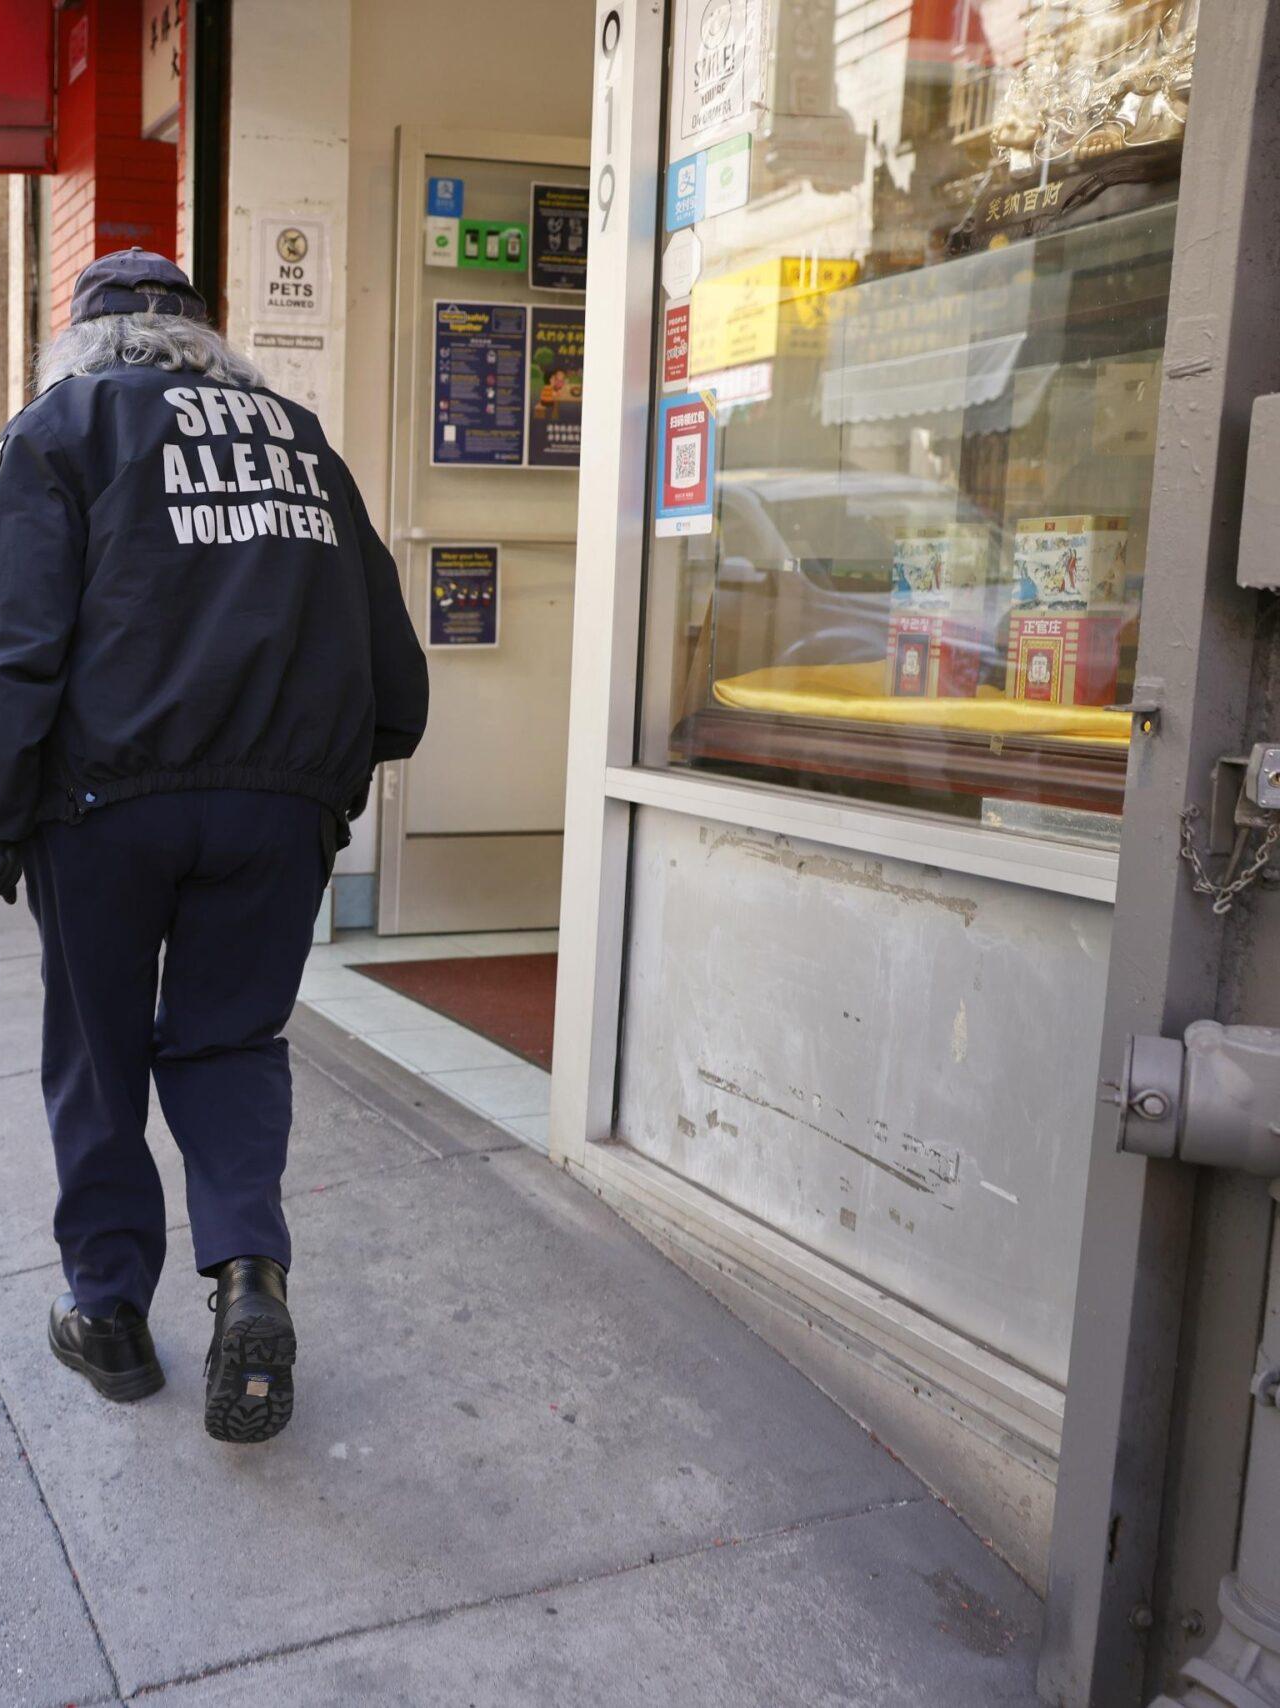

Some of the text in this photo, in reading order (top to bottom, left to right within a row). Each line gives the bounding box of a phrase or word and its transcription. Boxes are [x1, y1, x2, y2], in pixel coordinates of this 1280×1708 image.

[279, 265, 305, 280] NO
[269, 283, 314, 297] PETS
[267, 298, 315, 309] ALLOWED
[163, 386, 295, 441] SFPD
[162, 442, 330, 502] A.L.E.R.T.
[167, 499, 339, 547] VOLUNTEER
[1023, 620, 1062, 634] 正官庄
